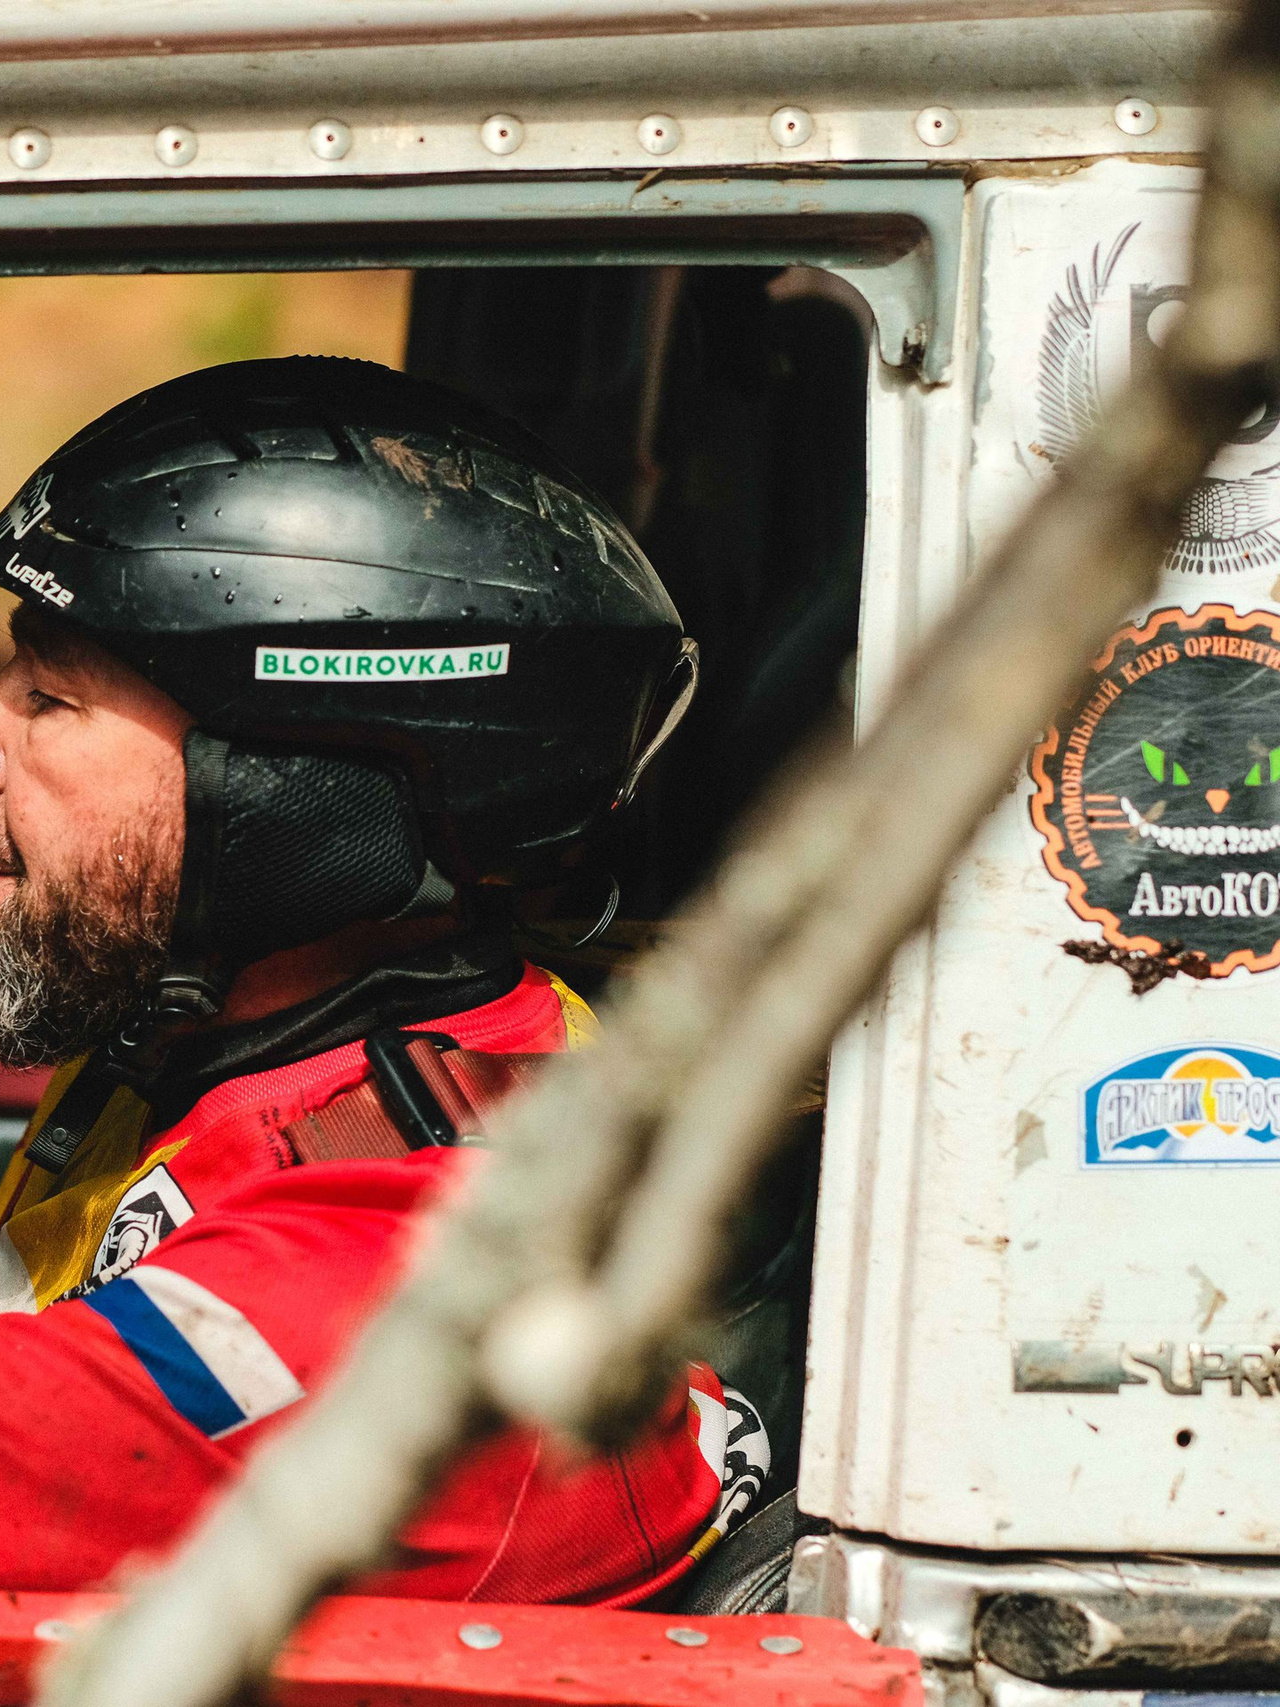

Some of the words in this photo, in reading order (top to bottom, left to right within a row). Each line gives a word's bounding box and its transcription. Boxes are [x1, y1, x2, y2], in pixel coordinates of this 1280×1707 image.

[262, 650, 503, 676] BLOKIROVKA.RU
[1061, 677, 1122, 870] АВТОМОБИЛЬНЫЙ
[1120, 642, 1180, 685] КЛУБ
[1128, 871, 1280, 917] АвтоКО
[1121, 1342, 1280, 1397] SUPR
